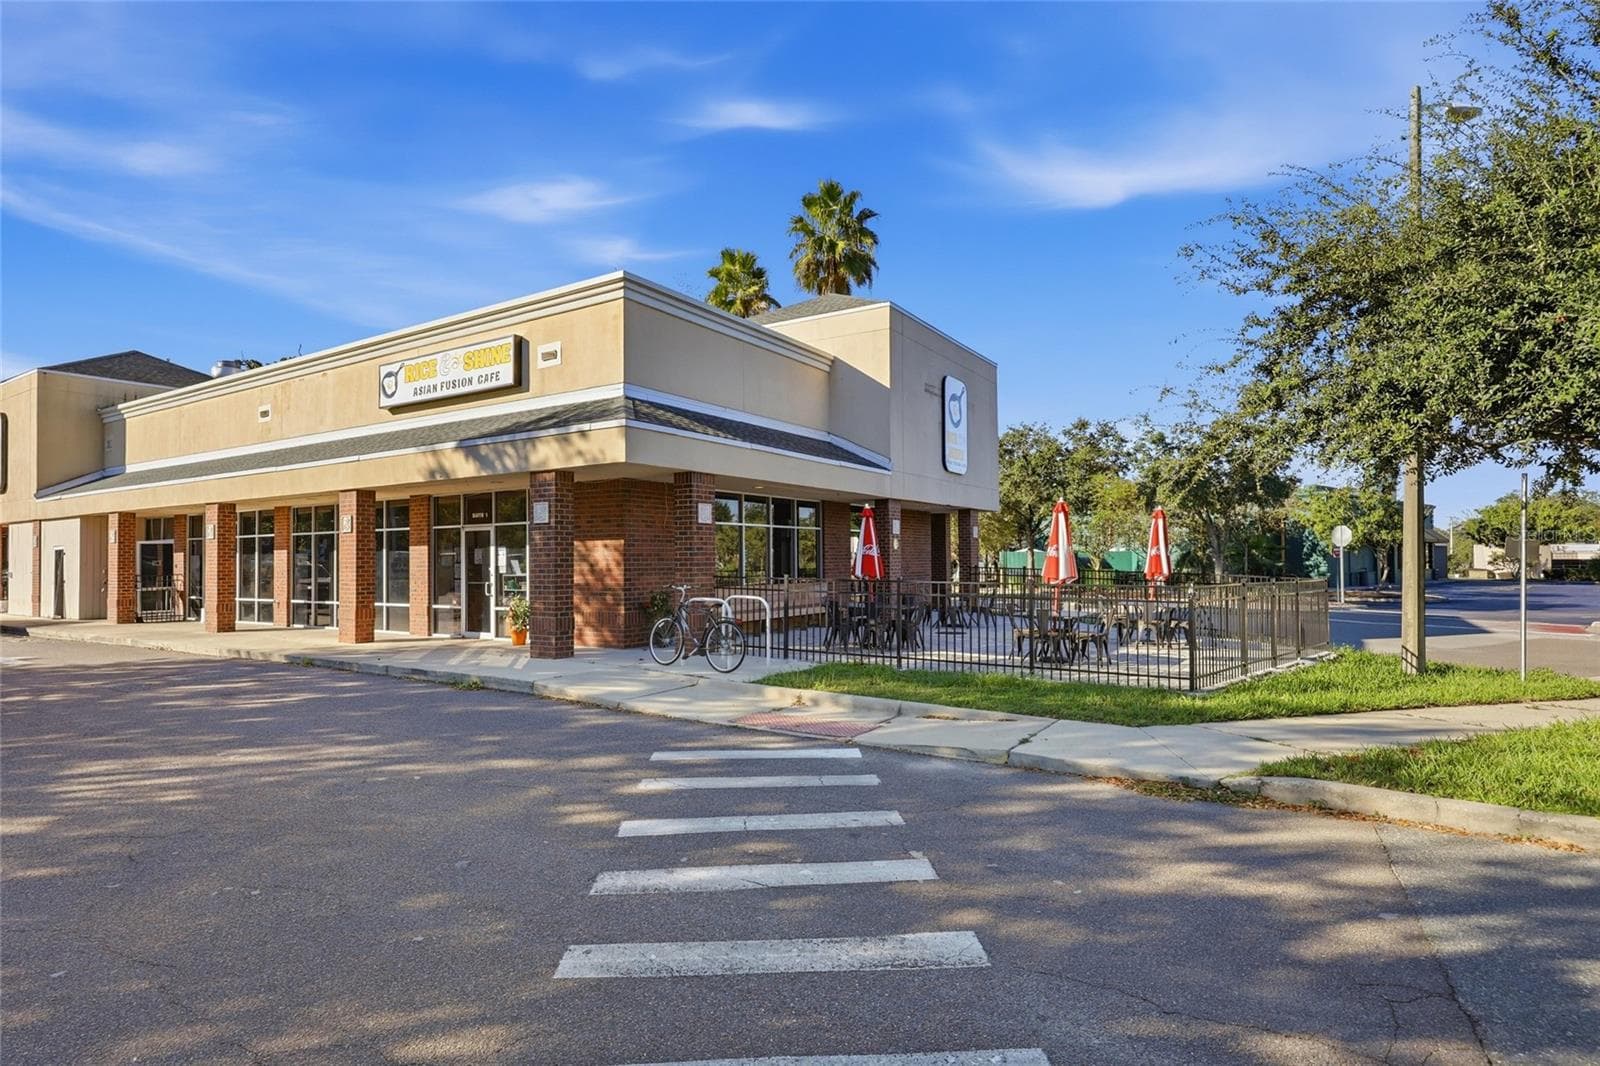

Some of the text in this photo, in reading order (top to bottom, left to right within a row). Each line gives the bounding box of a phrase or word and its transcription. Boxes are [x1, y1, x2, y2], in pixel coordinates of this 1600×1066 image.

[404, 342, 512, 383] RICE & SHINE
[412, 371, 501, 397] ASIAN FUSION CAFE
